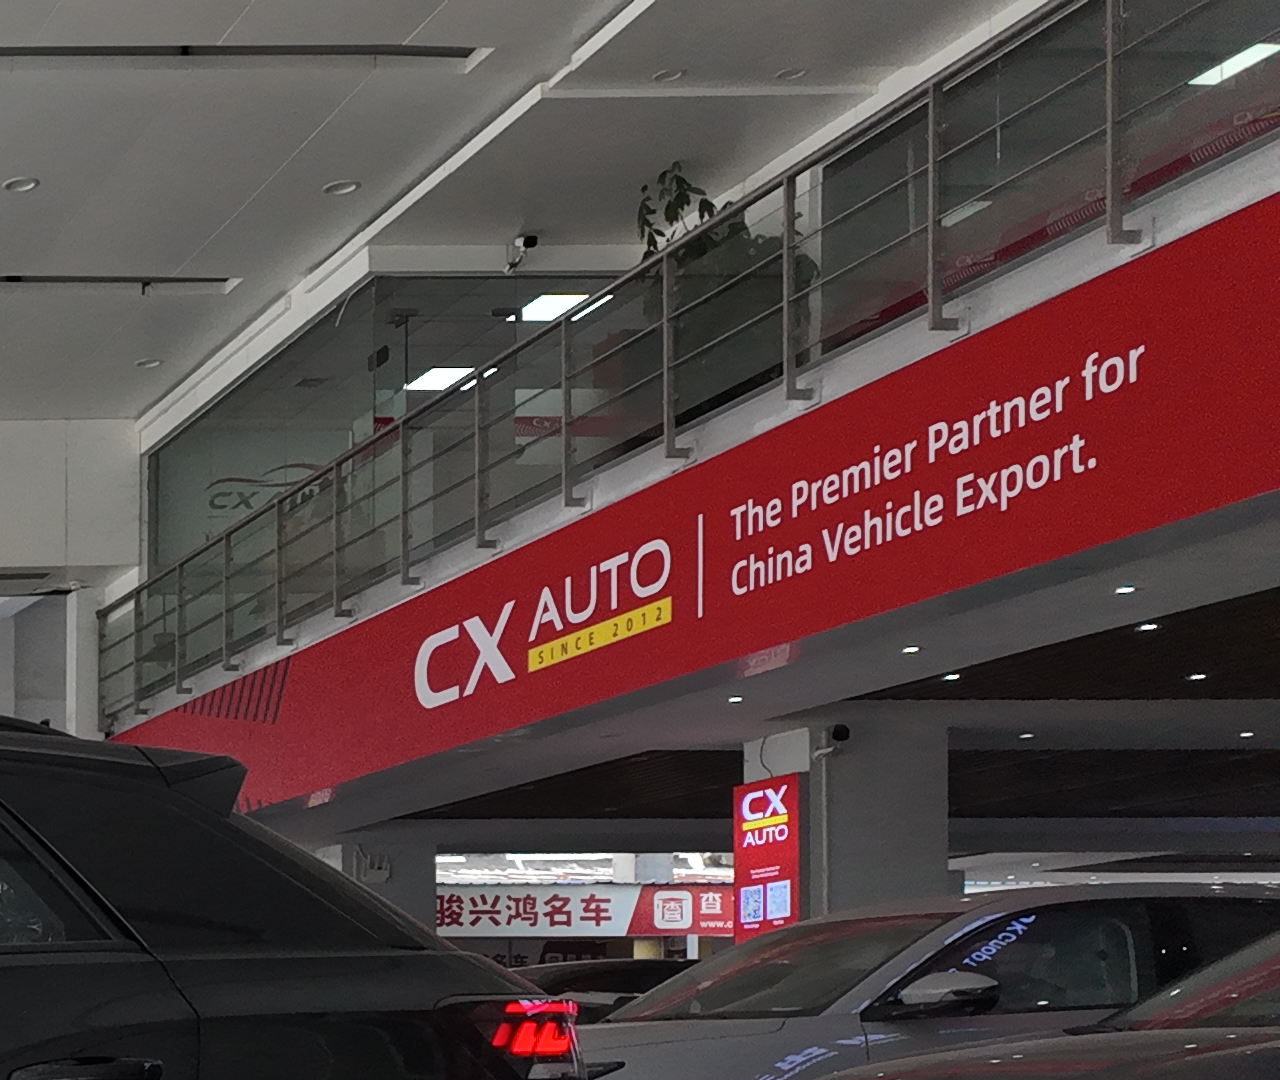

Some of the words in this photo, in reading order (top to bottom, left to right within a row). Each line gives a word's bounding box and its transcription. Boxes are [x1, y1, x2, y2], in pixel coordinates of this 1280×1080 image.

[730, 498, 782, 541] The
[791, 439, 918, 518] Premier
[928, 376, 1071, 464] Partner
[1082, 345, 1146, 401] for
[731, 542, 813, 596] China
[822, 490, 945, 563] Vehicle
[956, 433, 1097, 517] Export.
[414, 600, 516, 709] CX
[528, 538, 672, 643] AUTO
[538, 632, 595, 665] SINCE
[612, 606, 663, 638] 2012
[742, 784, 788, 821] CX
[743, 824, 789, 848] AUTO
[436, 893, 613, 927] 骏兴鸿名车
